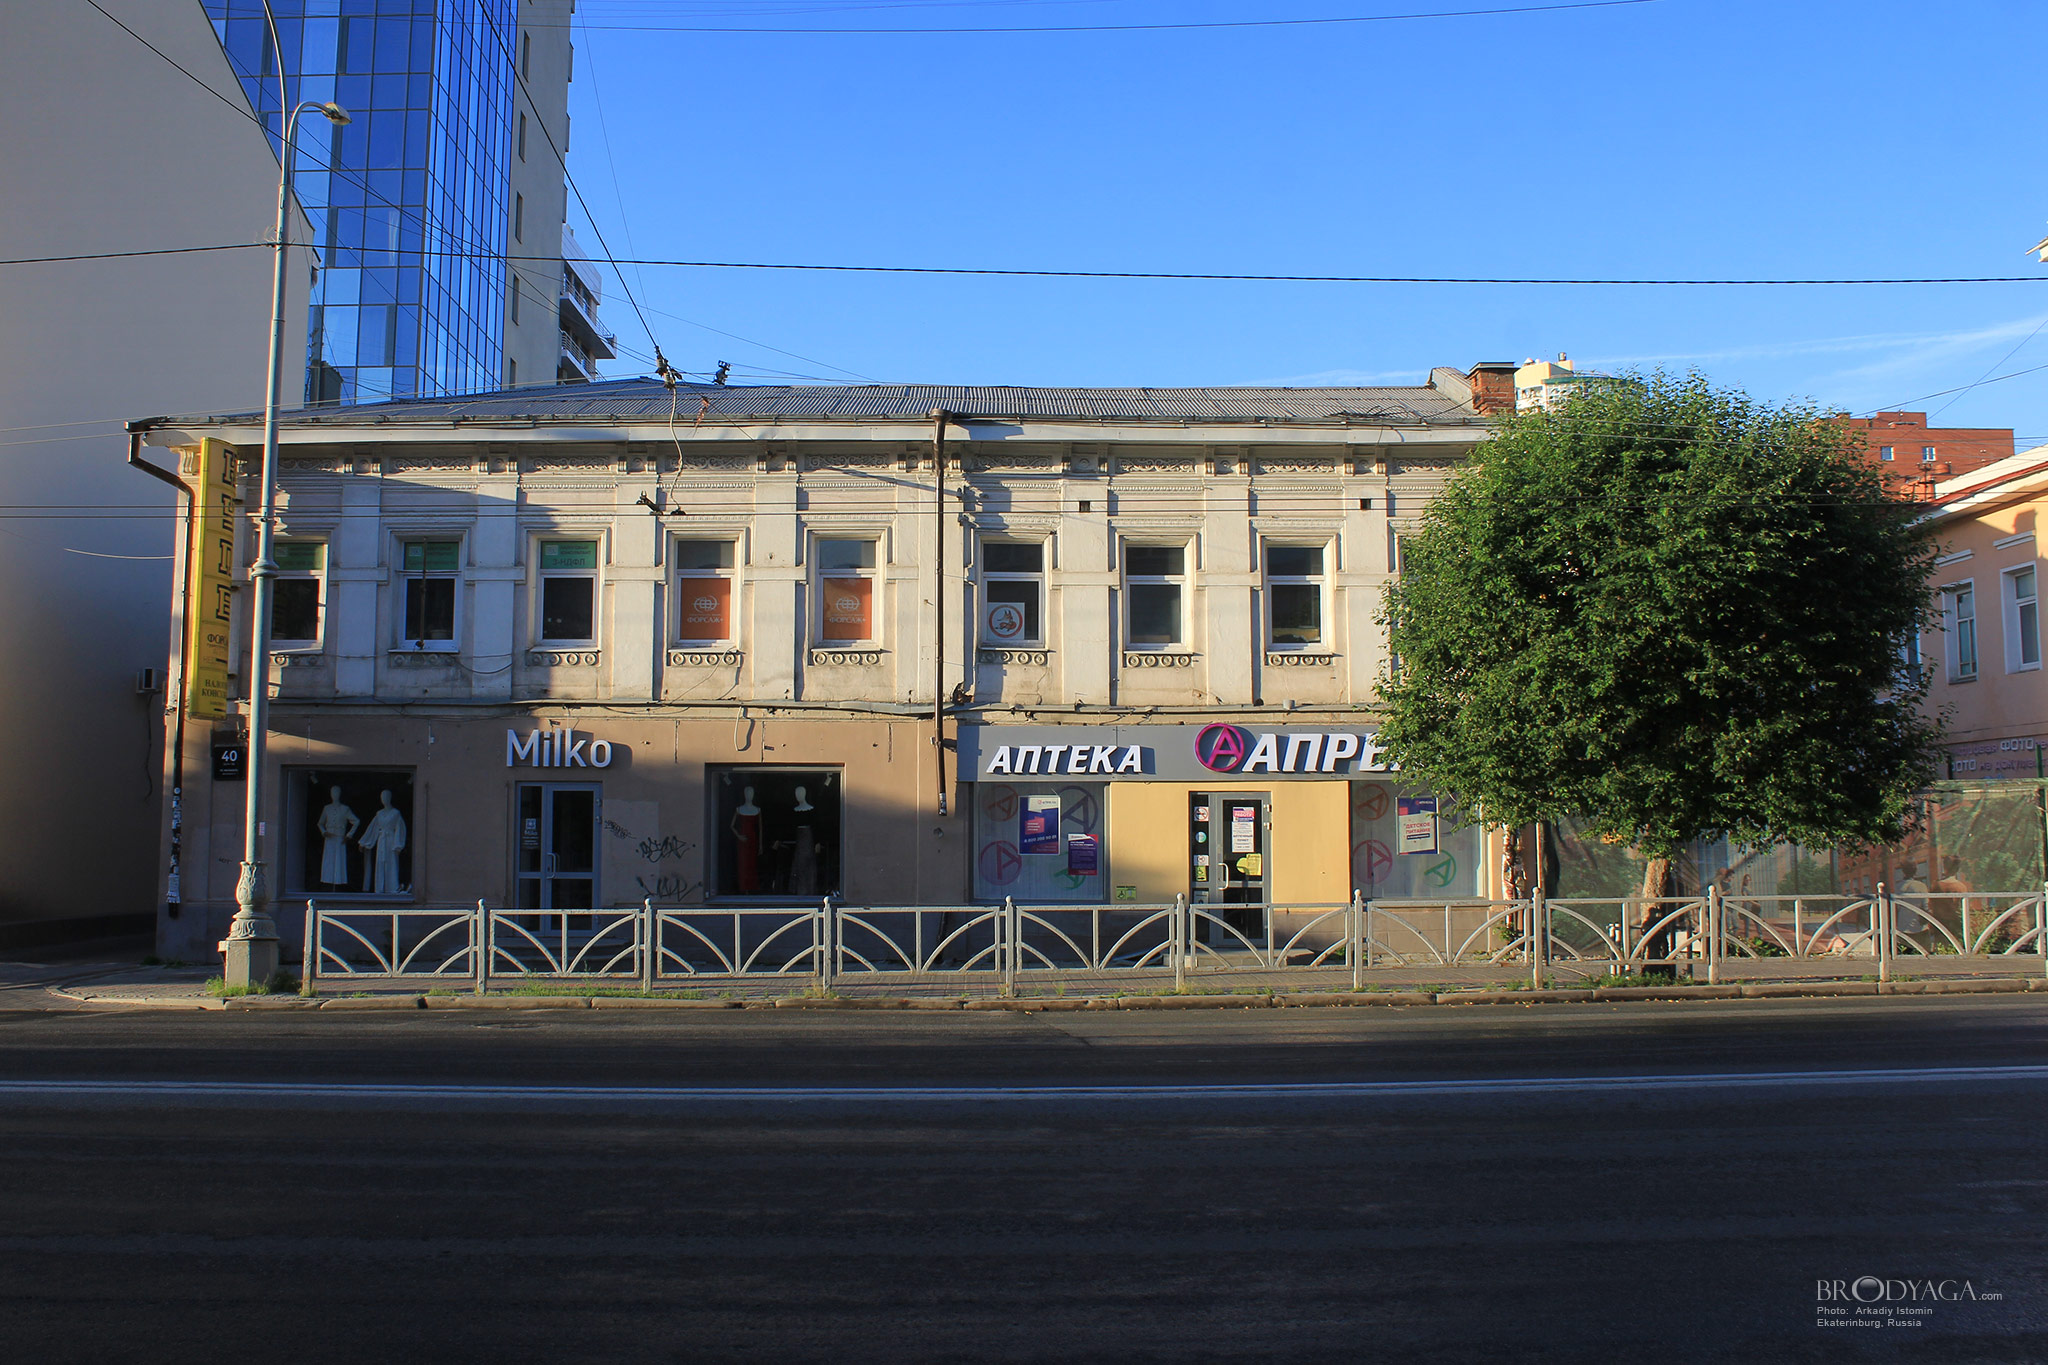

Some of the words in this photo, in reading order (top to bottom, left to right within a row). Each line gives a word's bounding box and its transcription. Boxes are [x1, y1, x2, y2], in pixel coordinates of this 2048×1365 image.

[221, 750, 238, 762] 40
[506, 728, 612, 768] Milko
[986, 744, 1143, 774] АПТЕКА
[1242, 733, 1402, 773] АПРЕ
[2000, 738, 2034, 751] ФОТО
